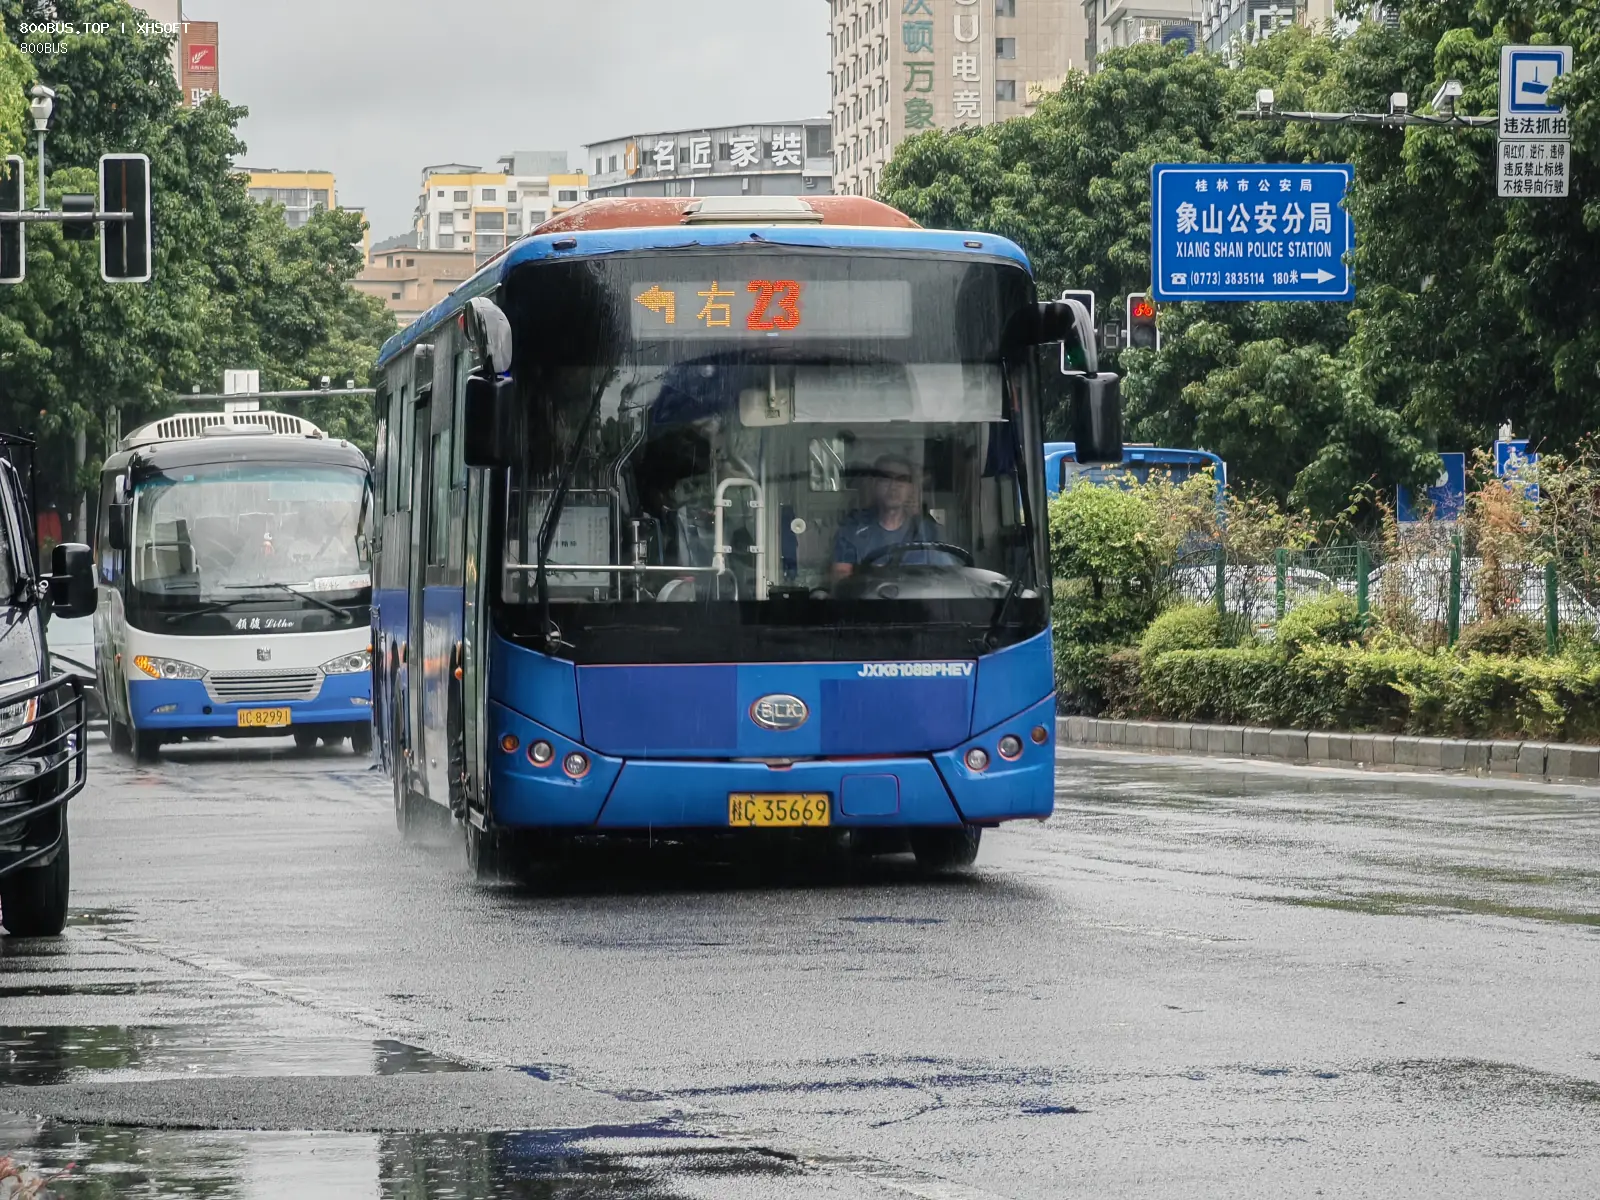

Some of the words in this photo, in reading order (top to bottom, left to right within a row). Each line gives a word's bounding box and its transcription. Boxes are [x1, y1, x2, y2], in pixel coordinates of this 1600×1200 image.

[952, 0, 981, 119] U电竞
[1503, 117, 1567, 134] 违法抓拍
[1503, 161, 1564, 177] 违反禁止标线
[1195, 178, 1313, 193] 桂林市公安局
[1503, 179, 1564, 194] 不按导向行驶
[1175, 201, 1331, 235] 象山公安分局
[1176, 242, 1210, 258] XIANG
[1214, 241, 1243, 258] SHAN
[1247, 241, 1284, 258] POLICE
[1288, 241, 1332, 258] STATION
[1190, 271, 1221, 286] (0773)
[1224, 272, 1265, 285] 3835114
[1272, 270, 1299, 285] 180米
[697, 280, 735, 327] 右
[747, 280, 800, 330] 23
